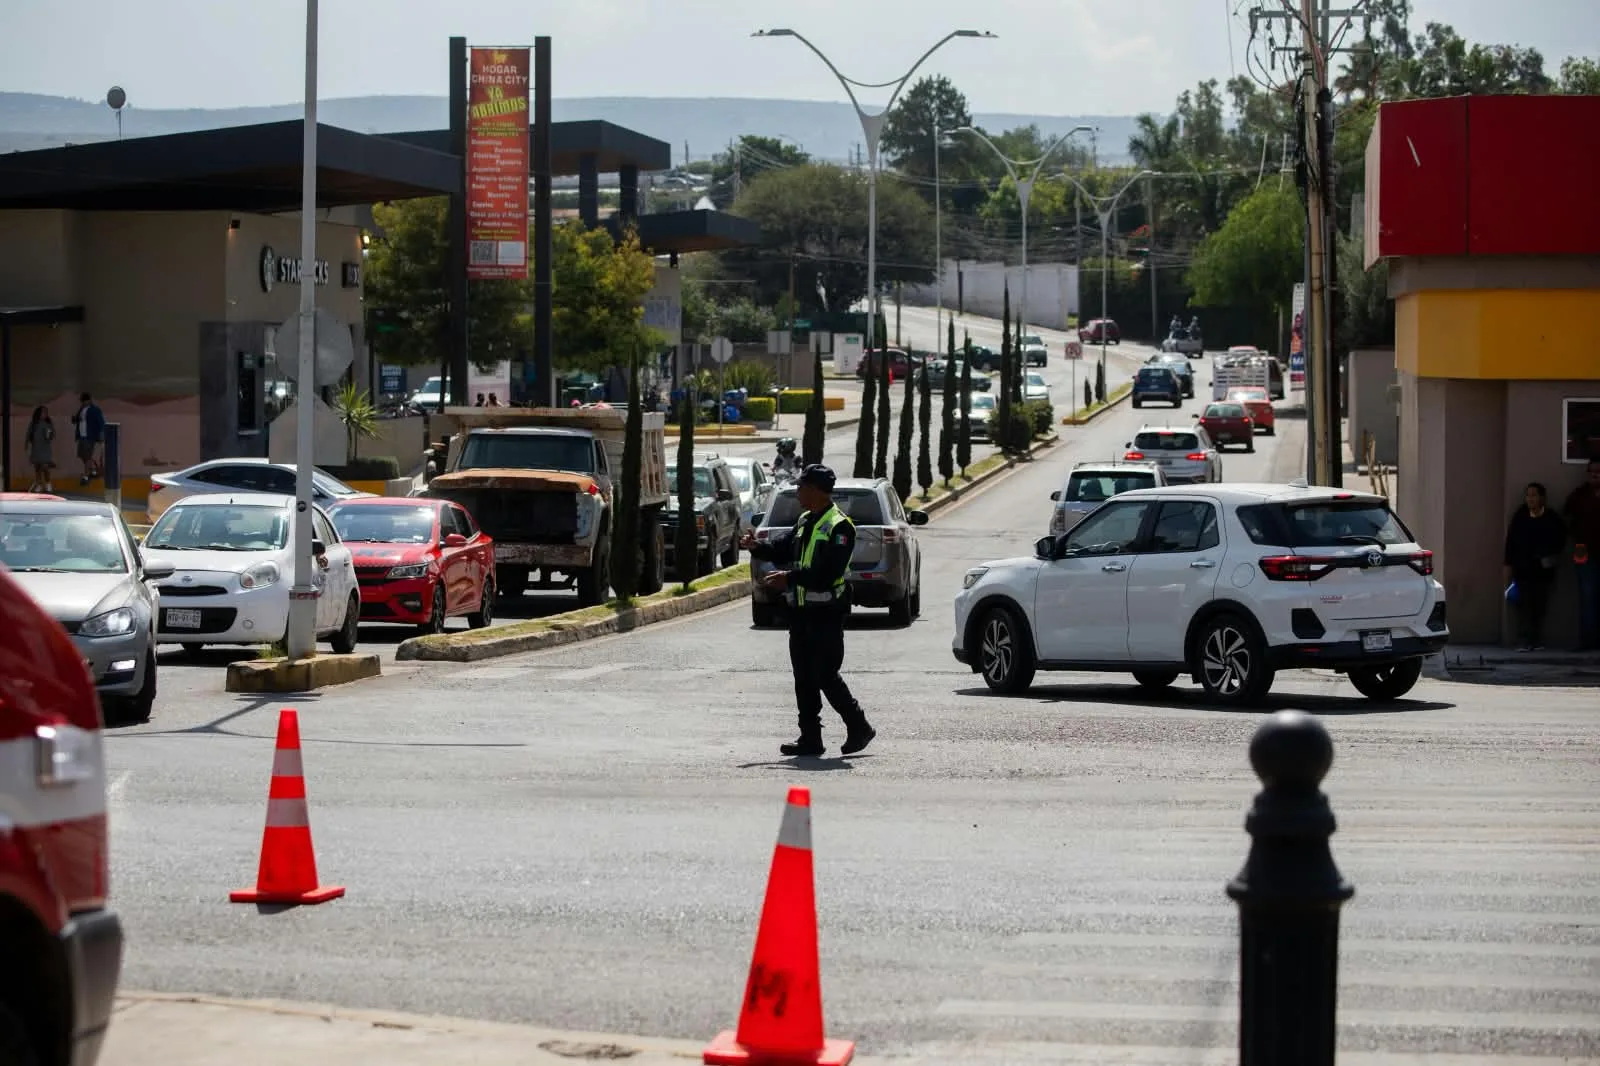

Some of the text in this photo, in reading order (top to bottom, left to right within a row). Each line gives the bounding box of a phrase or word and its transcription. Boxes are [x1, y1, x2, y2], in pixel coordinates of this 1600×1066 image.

[482, 64, 518, 74] HOGAR
[471, 74, 528, 85] CHINA CITY
[281, 258, 328, 285] STARCKS
